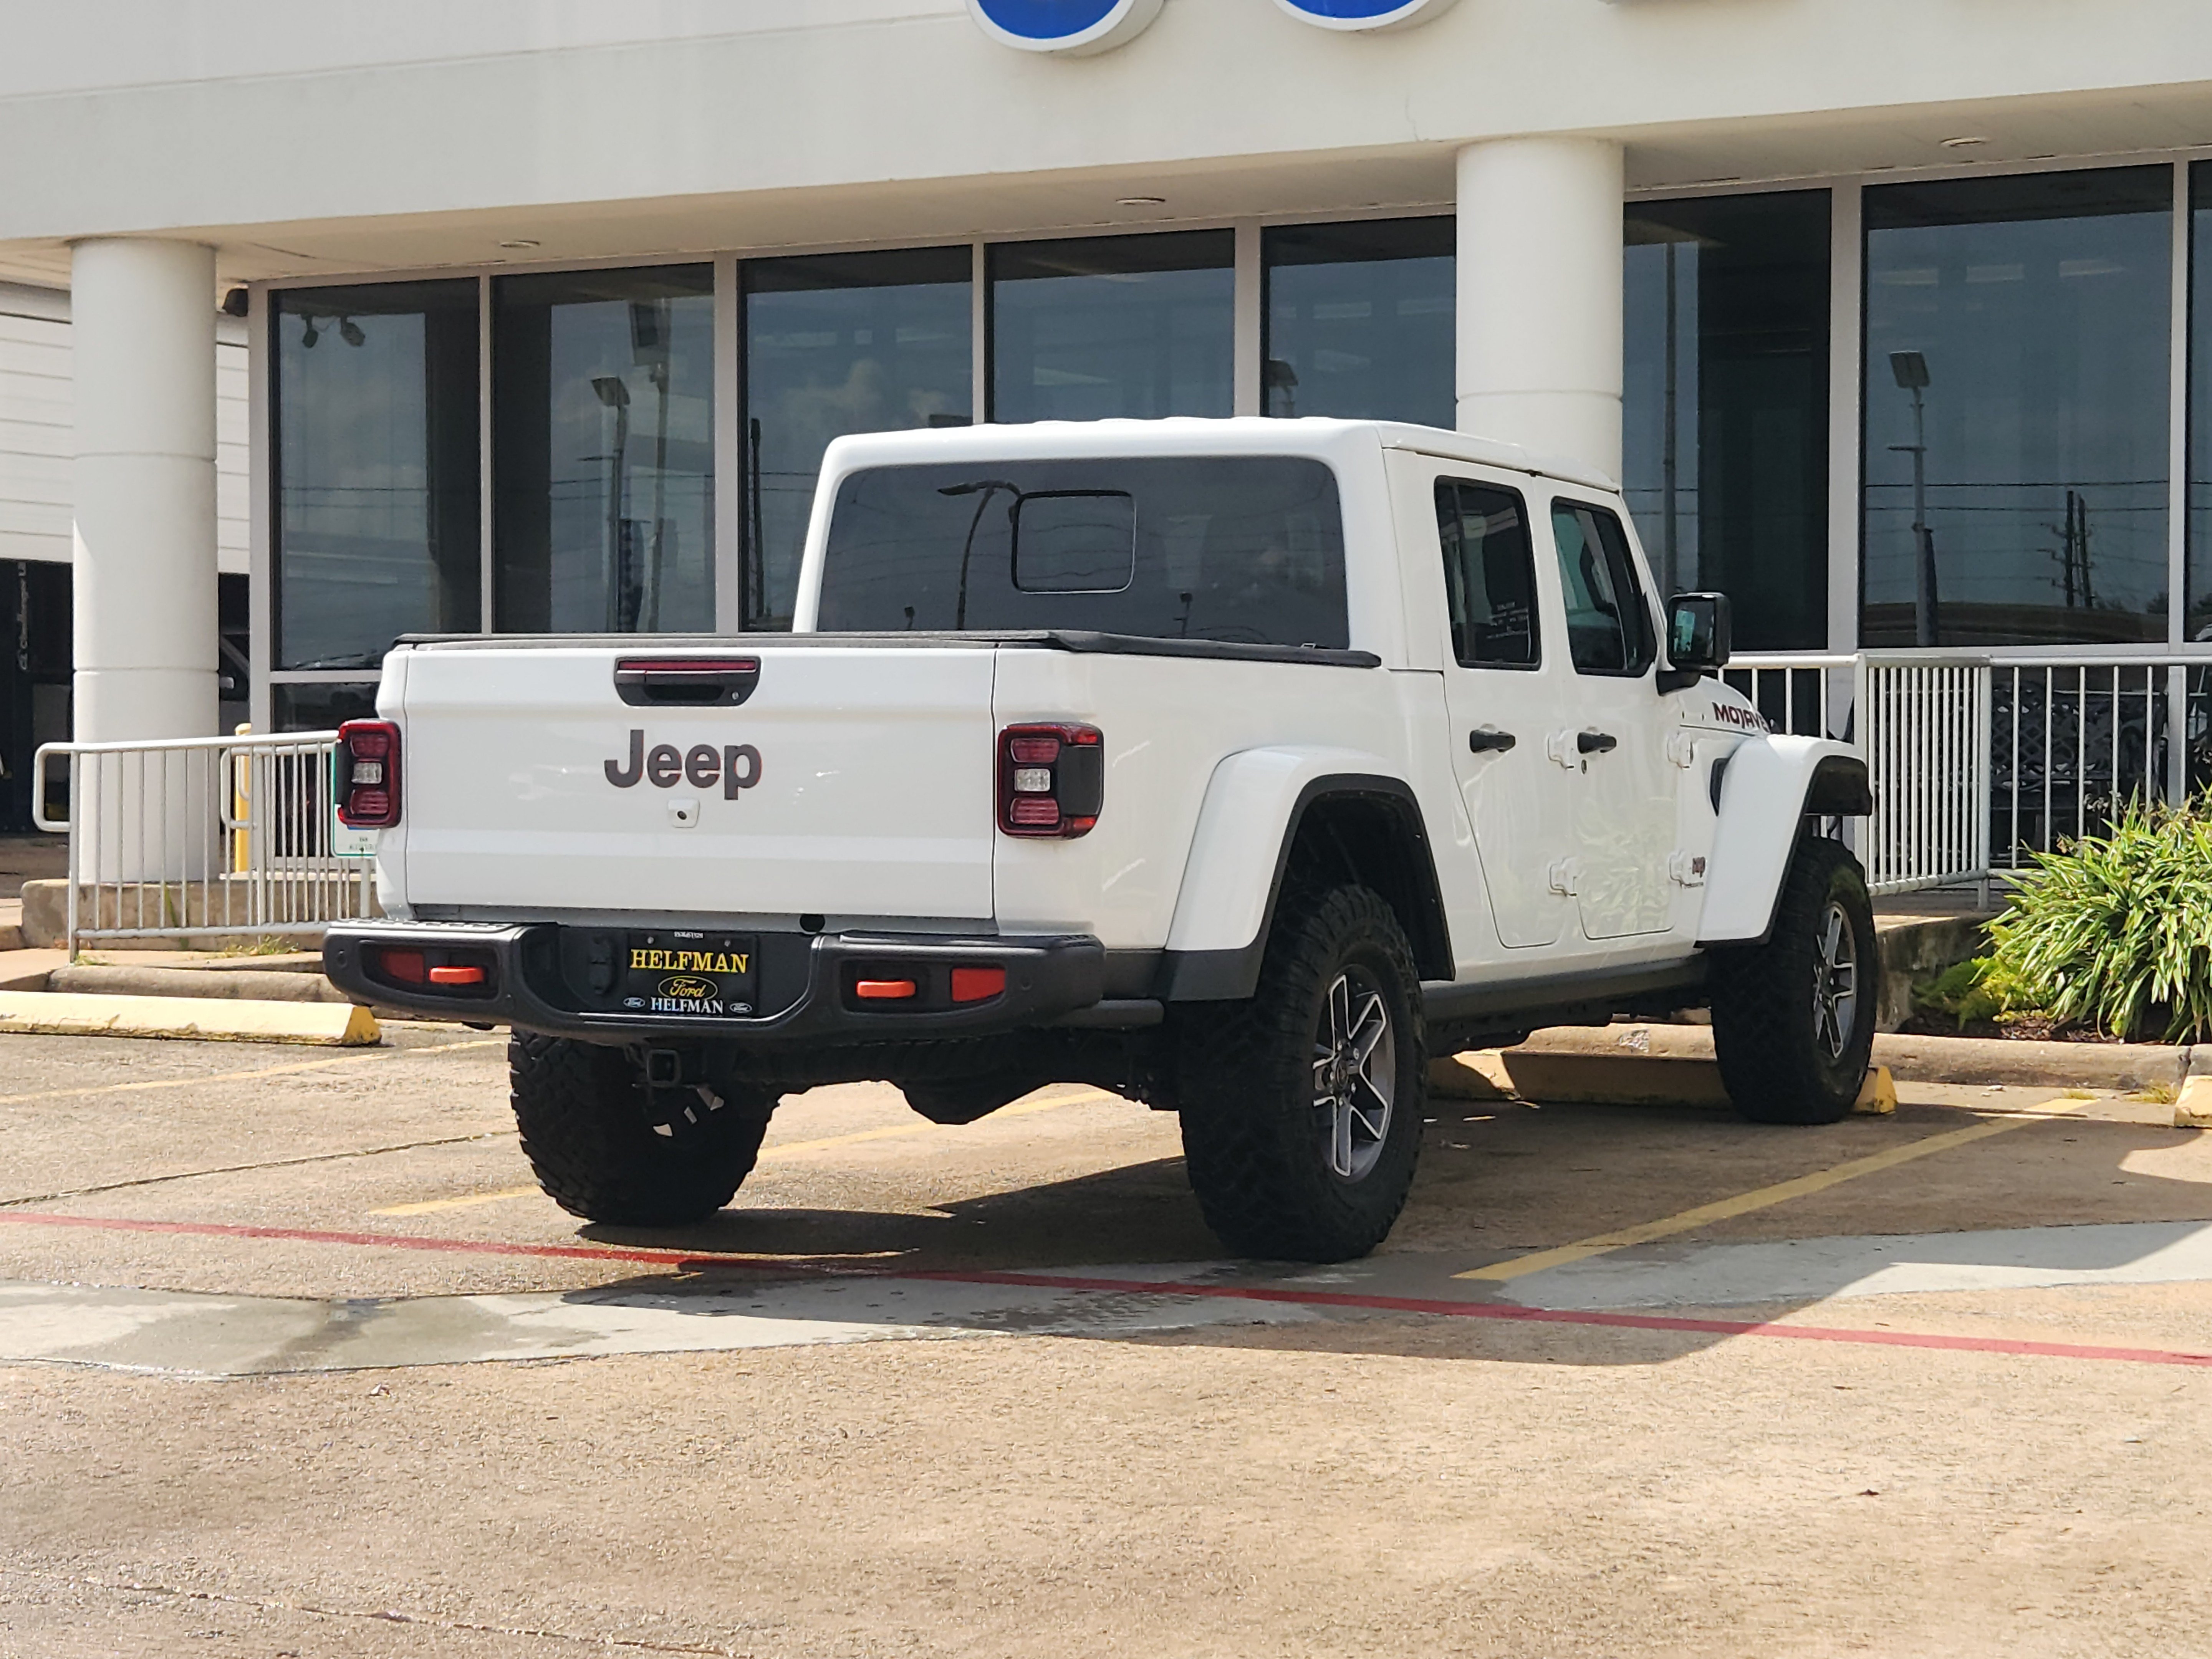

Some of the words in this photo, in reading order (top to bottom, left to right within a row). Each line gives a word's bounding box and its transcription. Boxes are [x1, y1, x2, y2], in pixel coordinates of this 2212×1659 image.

[1712, 702, 1770, 733] MOJAVE
[604, 729, 762, 800] Jeep
[629, 949, 749, 974] HELFMAN
[670, 979, 707, 997] Ford
[651, 997, 724, 1014] HELFMAN
